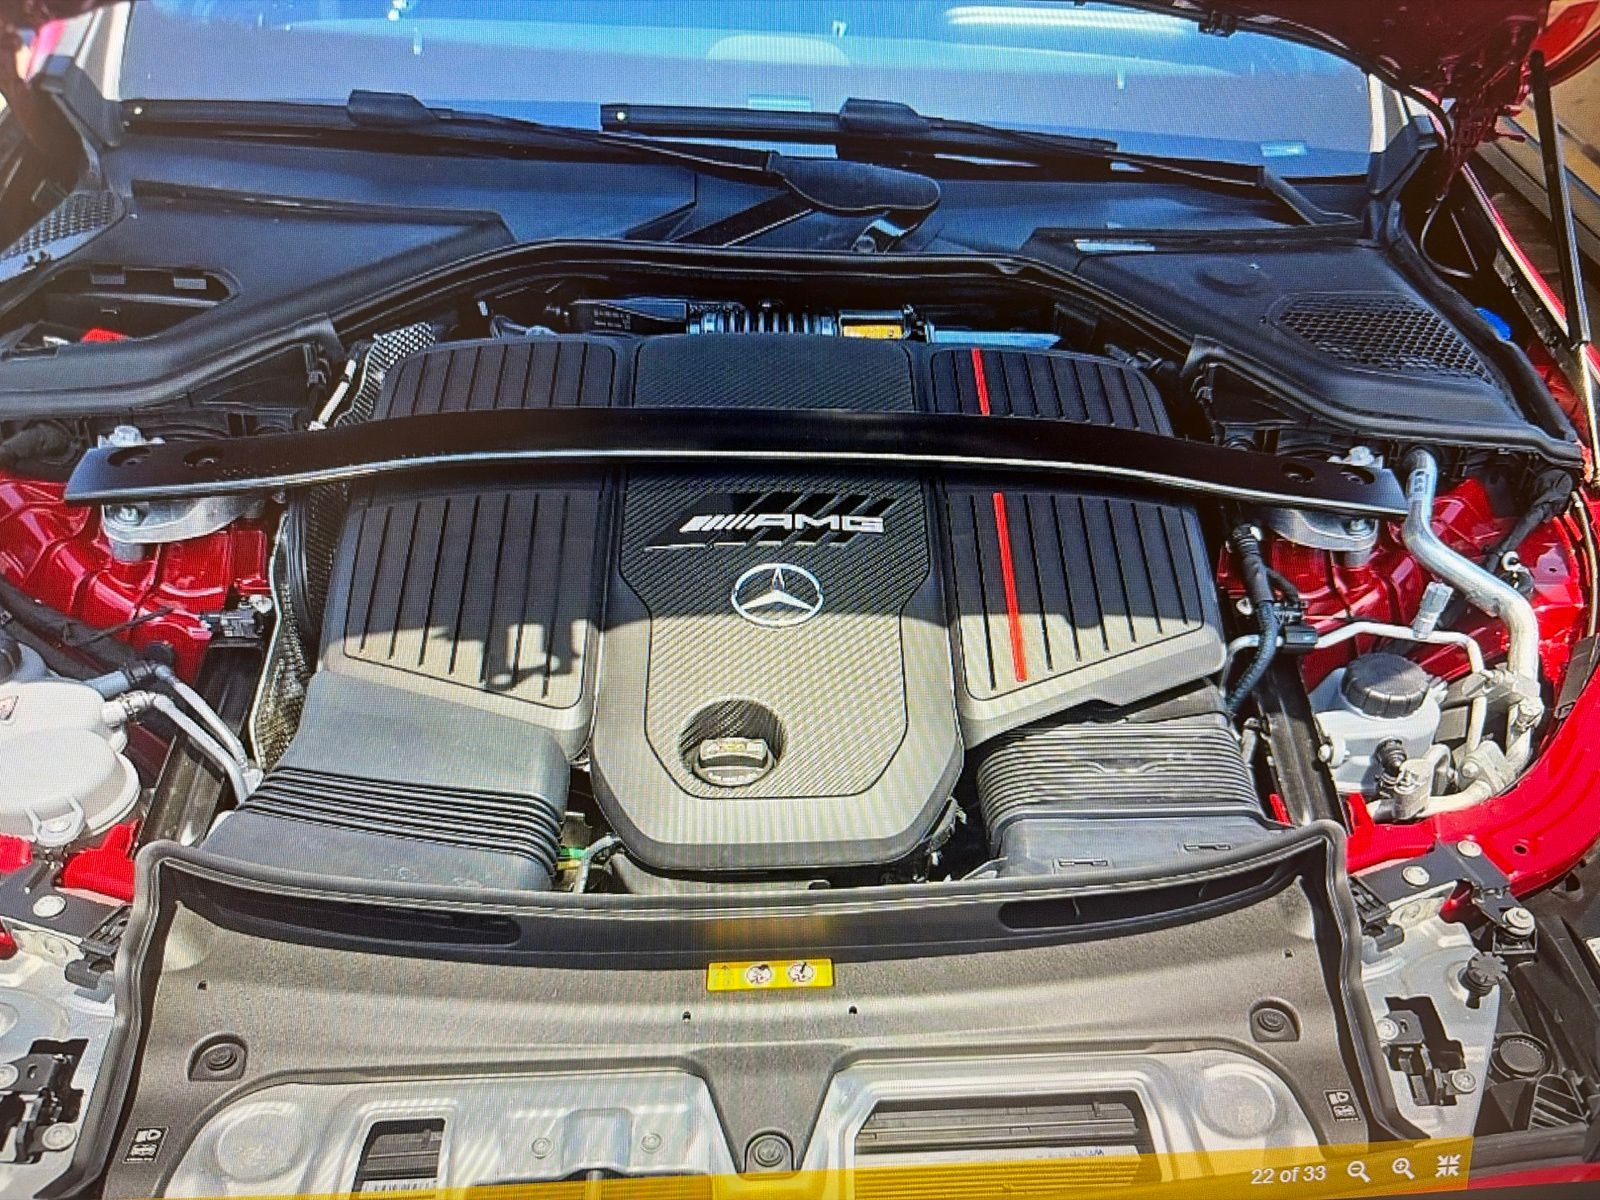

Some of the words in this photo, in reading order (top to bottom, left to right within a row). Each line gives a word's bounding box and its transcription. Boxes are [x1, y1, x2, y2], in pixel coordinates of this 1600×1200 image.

[744, 513, 885, 533] AMG
[1251, 1168, 1275, 1185] 22
[1280, 1166, 1300, 1183] of
[1303, 1165, 1326, 1181] 33
